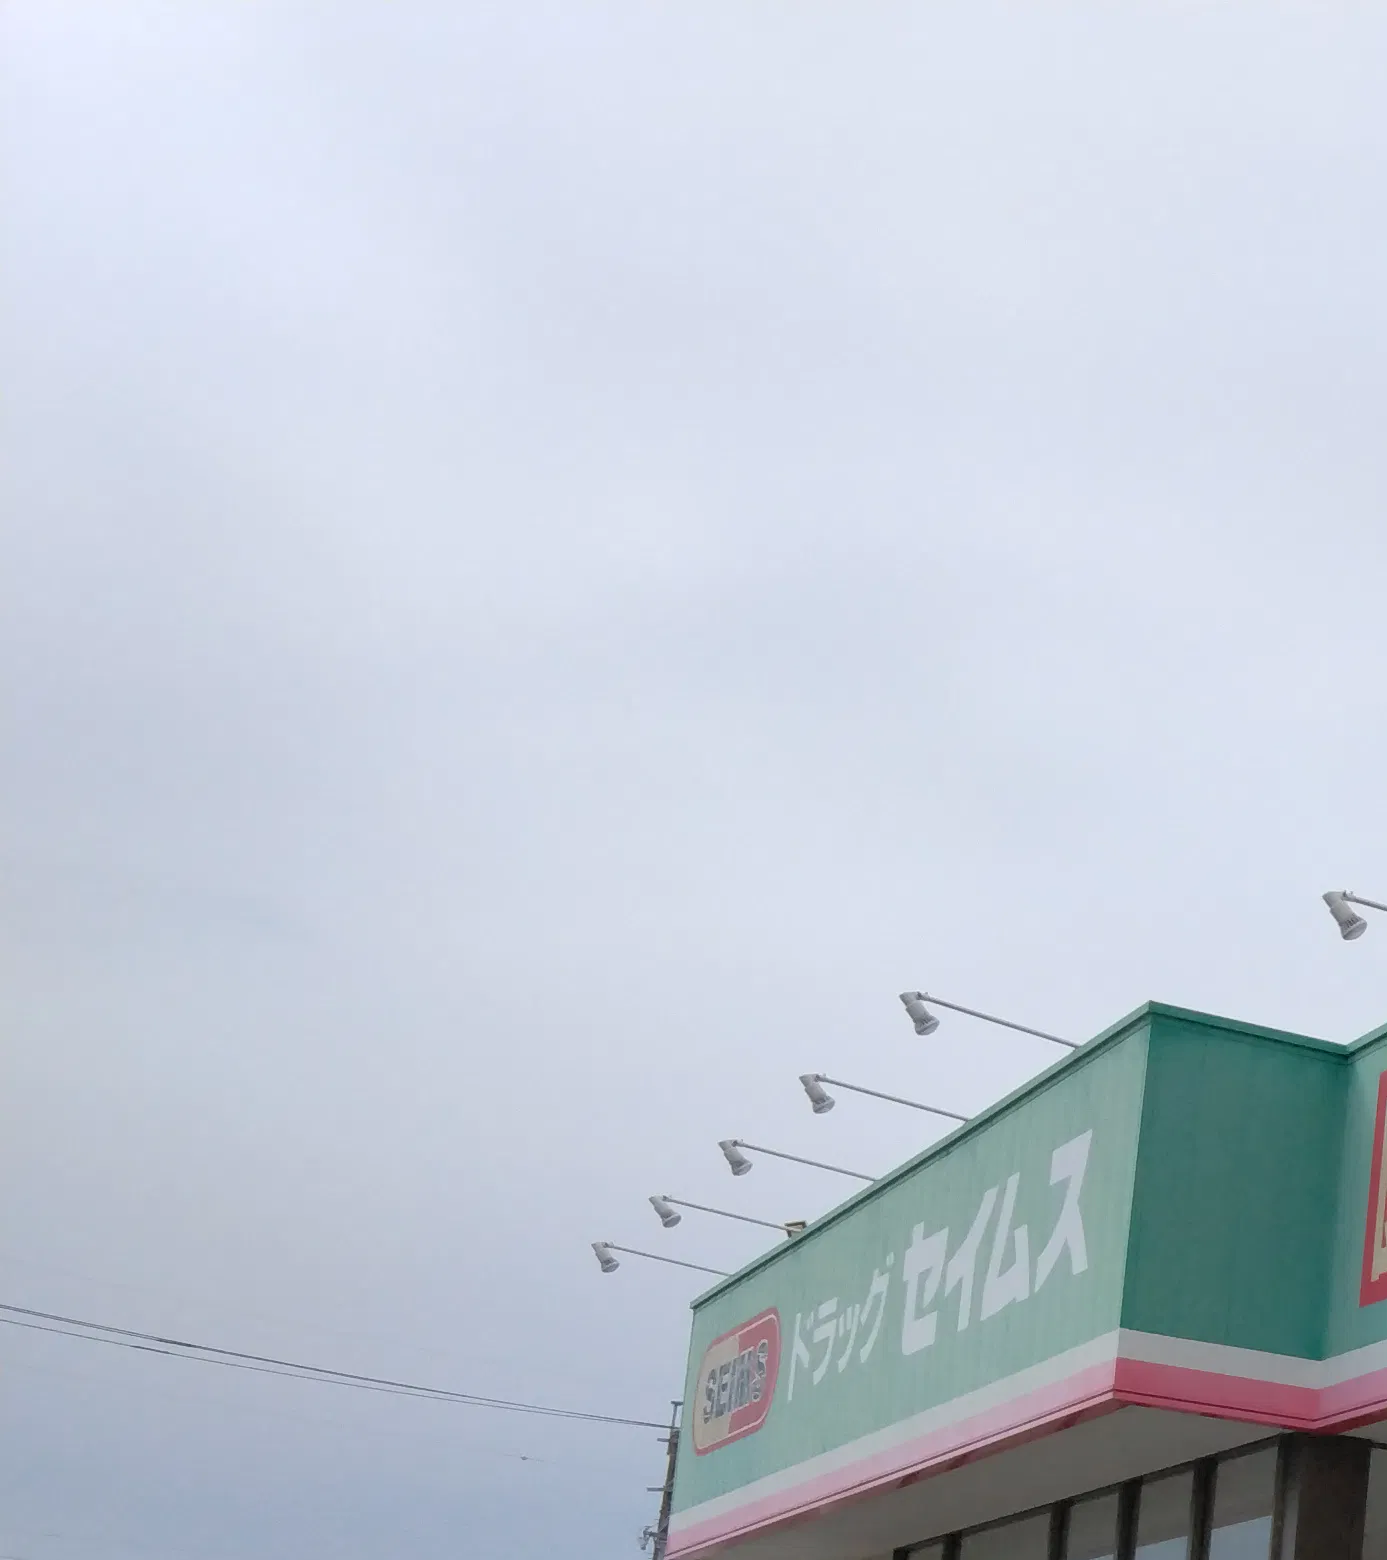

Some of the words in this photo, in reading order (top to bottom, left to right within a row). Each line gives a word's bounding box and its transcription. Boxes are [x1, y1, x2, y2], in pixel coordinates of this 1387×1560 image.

[787, 1252, 896, 1403] ドラッグ
[901, 1128, 1093, 1357] セイムス
